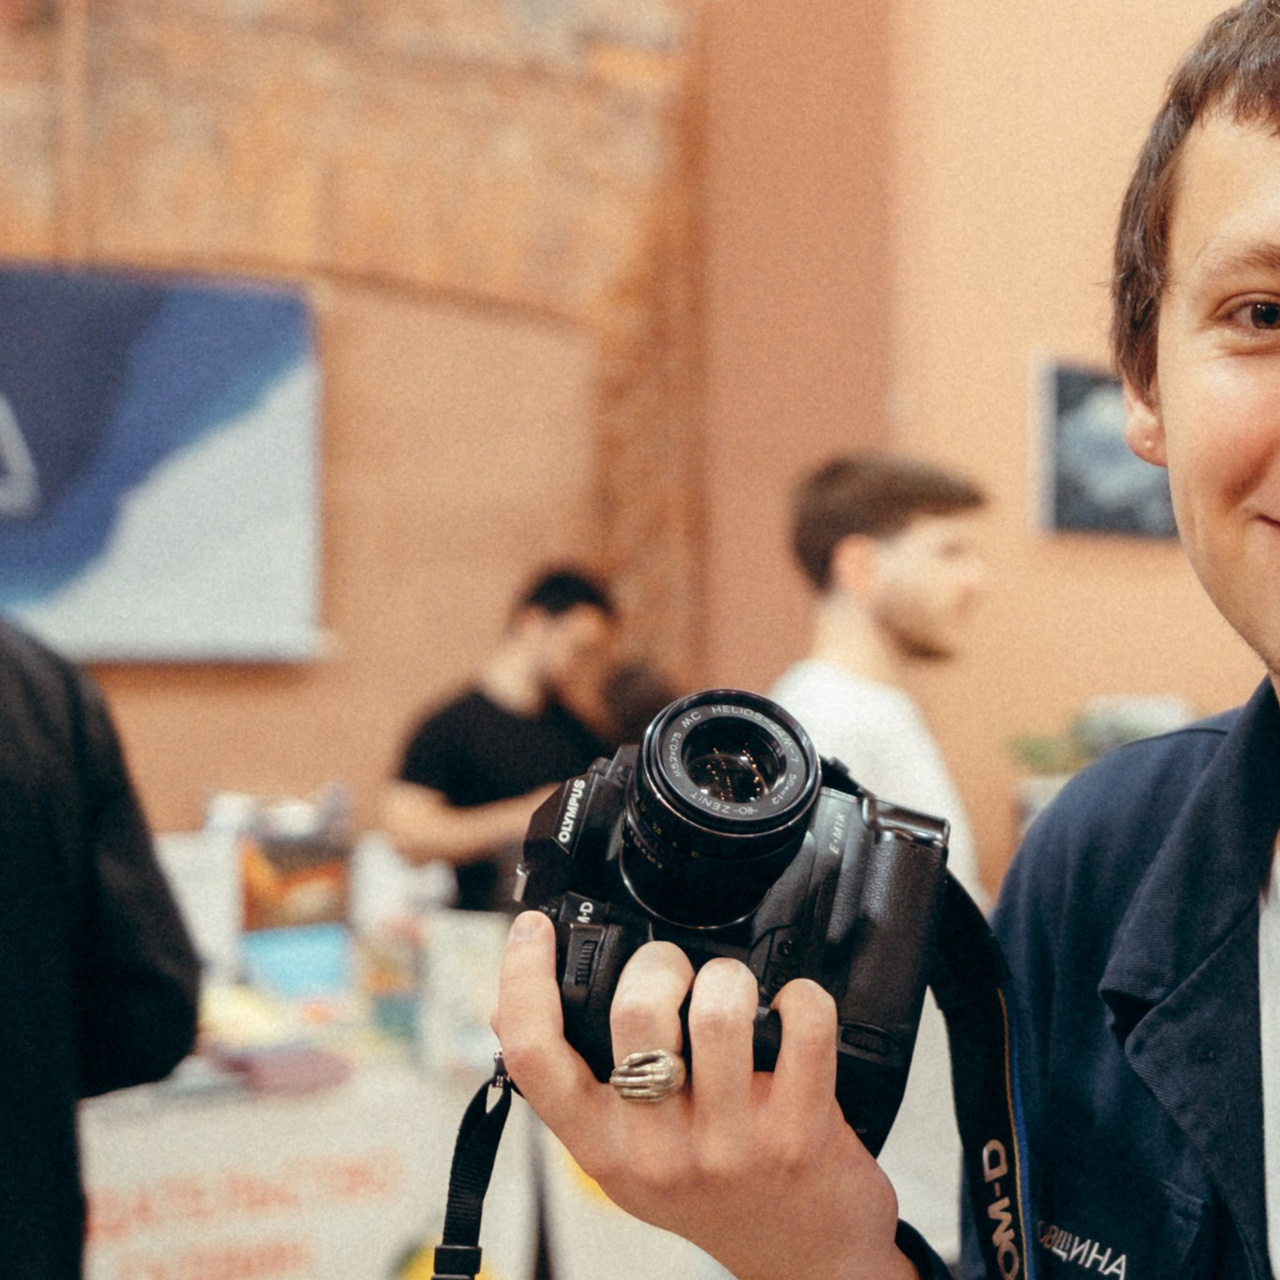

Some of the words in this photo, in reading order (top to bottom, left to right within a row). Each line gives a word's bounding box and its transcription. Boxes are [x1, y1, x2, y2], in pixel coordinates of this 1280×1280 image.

[681, 711, 702, 729] MC
[558, 779, 586, 843] OLYMPUS
[689, 791, 731, 814] ZENIT
